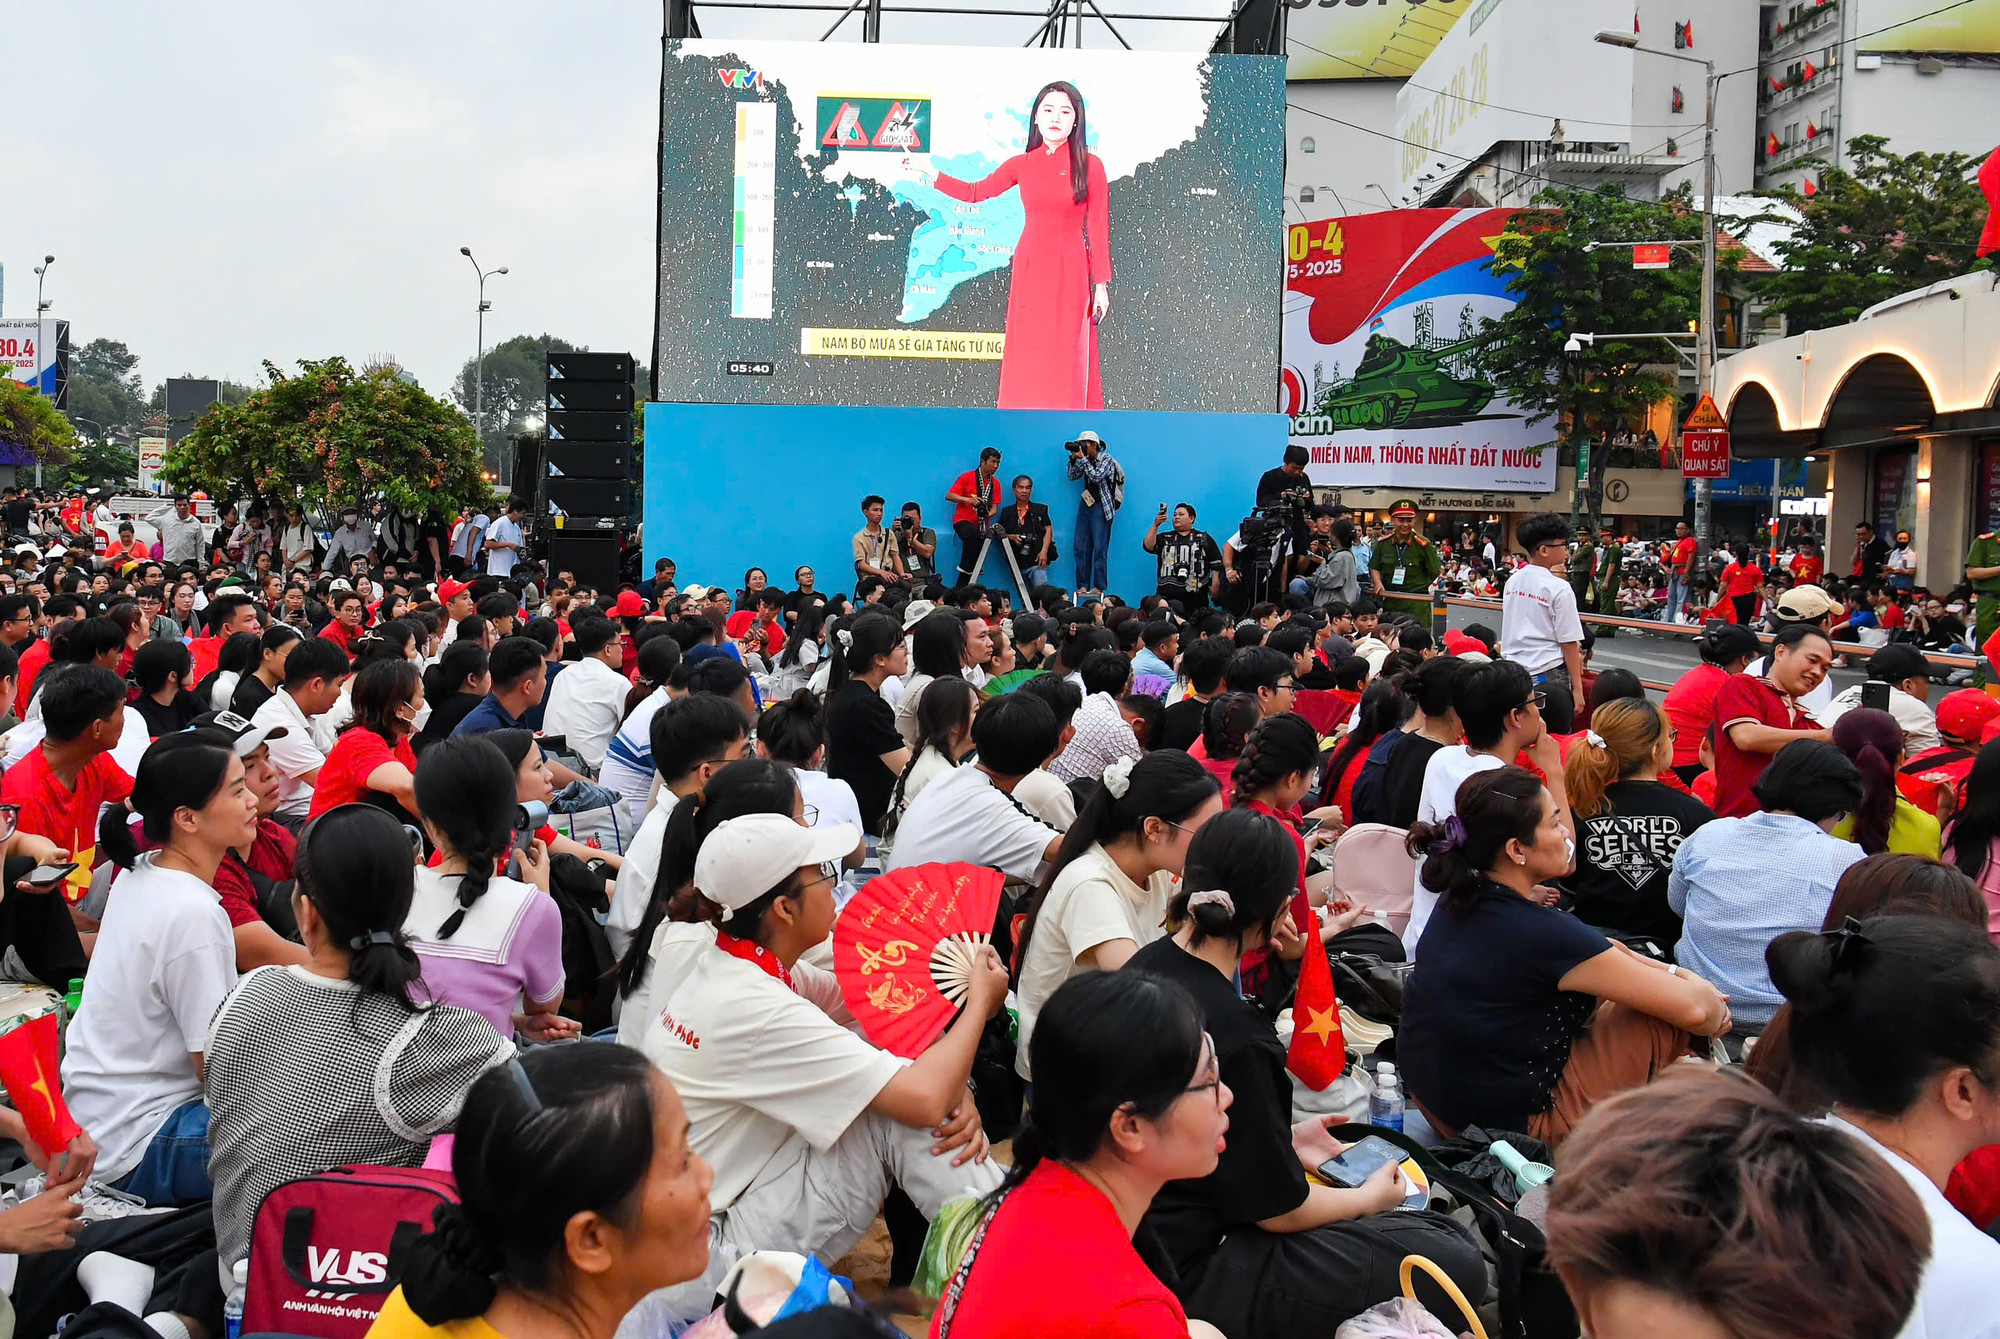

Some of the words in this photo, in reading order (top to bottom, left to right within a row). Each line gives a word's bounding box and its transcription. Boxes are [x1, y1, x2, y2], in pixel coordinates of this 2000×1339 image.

[718, 69, 763, 88] VTV1
[1287, 259, 1342, 278] 5-2025
[822, 336, 848, 349] NAM
[851, 334, 866, 353] BỘ
[869, 337, 896, 351] MƯA
[899, 336, 912, 351] SẼ
[914, 339, 933, 352] GIA
[936, 337, 967, 353] TĂNG
[969, 337, 985, 353] TỪ
[986, 340, 1003, 354] NG
[730, 364, 770, 374] 05:40
[1702, 404, 1711, 413] ĐI
[1311, 440, 1341, 464] MIỀN
[1344, 446, 1375, 465] NAM,
[1379, 440, 1424, 464] THỐNG
[1428, 440, 1466, 466] NHẤT
[1470, 442, 1498, 467] ĐẤT
[1692, 437, 1711, 452] CHÚ
[1714, 436, 1720, 451] Ý
[1684, 459, 1709, 471] QUAN
[1711, 456, 1727, 471] SÁT
[1590, 817, 1678, 835] WORLD
[1586, 834, 1682, 862] SERIES
[307, 1245, 389, 1285] VUS
[282, 1300, 307, 1312] ANH
[327, 1305, 345, 1318] HỘI
[345, 1307, 369, 1320] VIỆT
[368, 1311, 381, 1320] M
